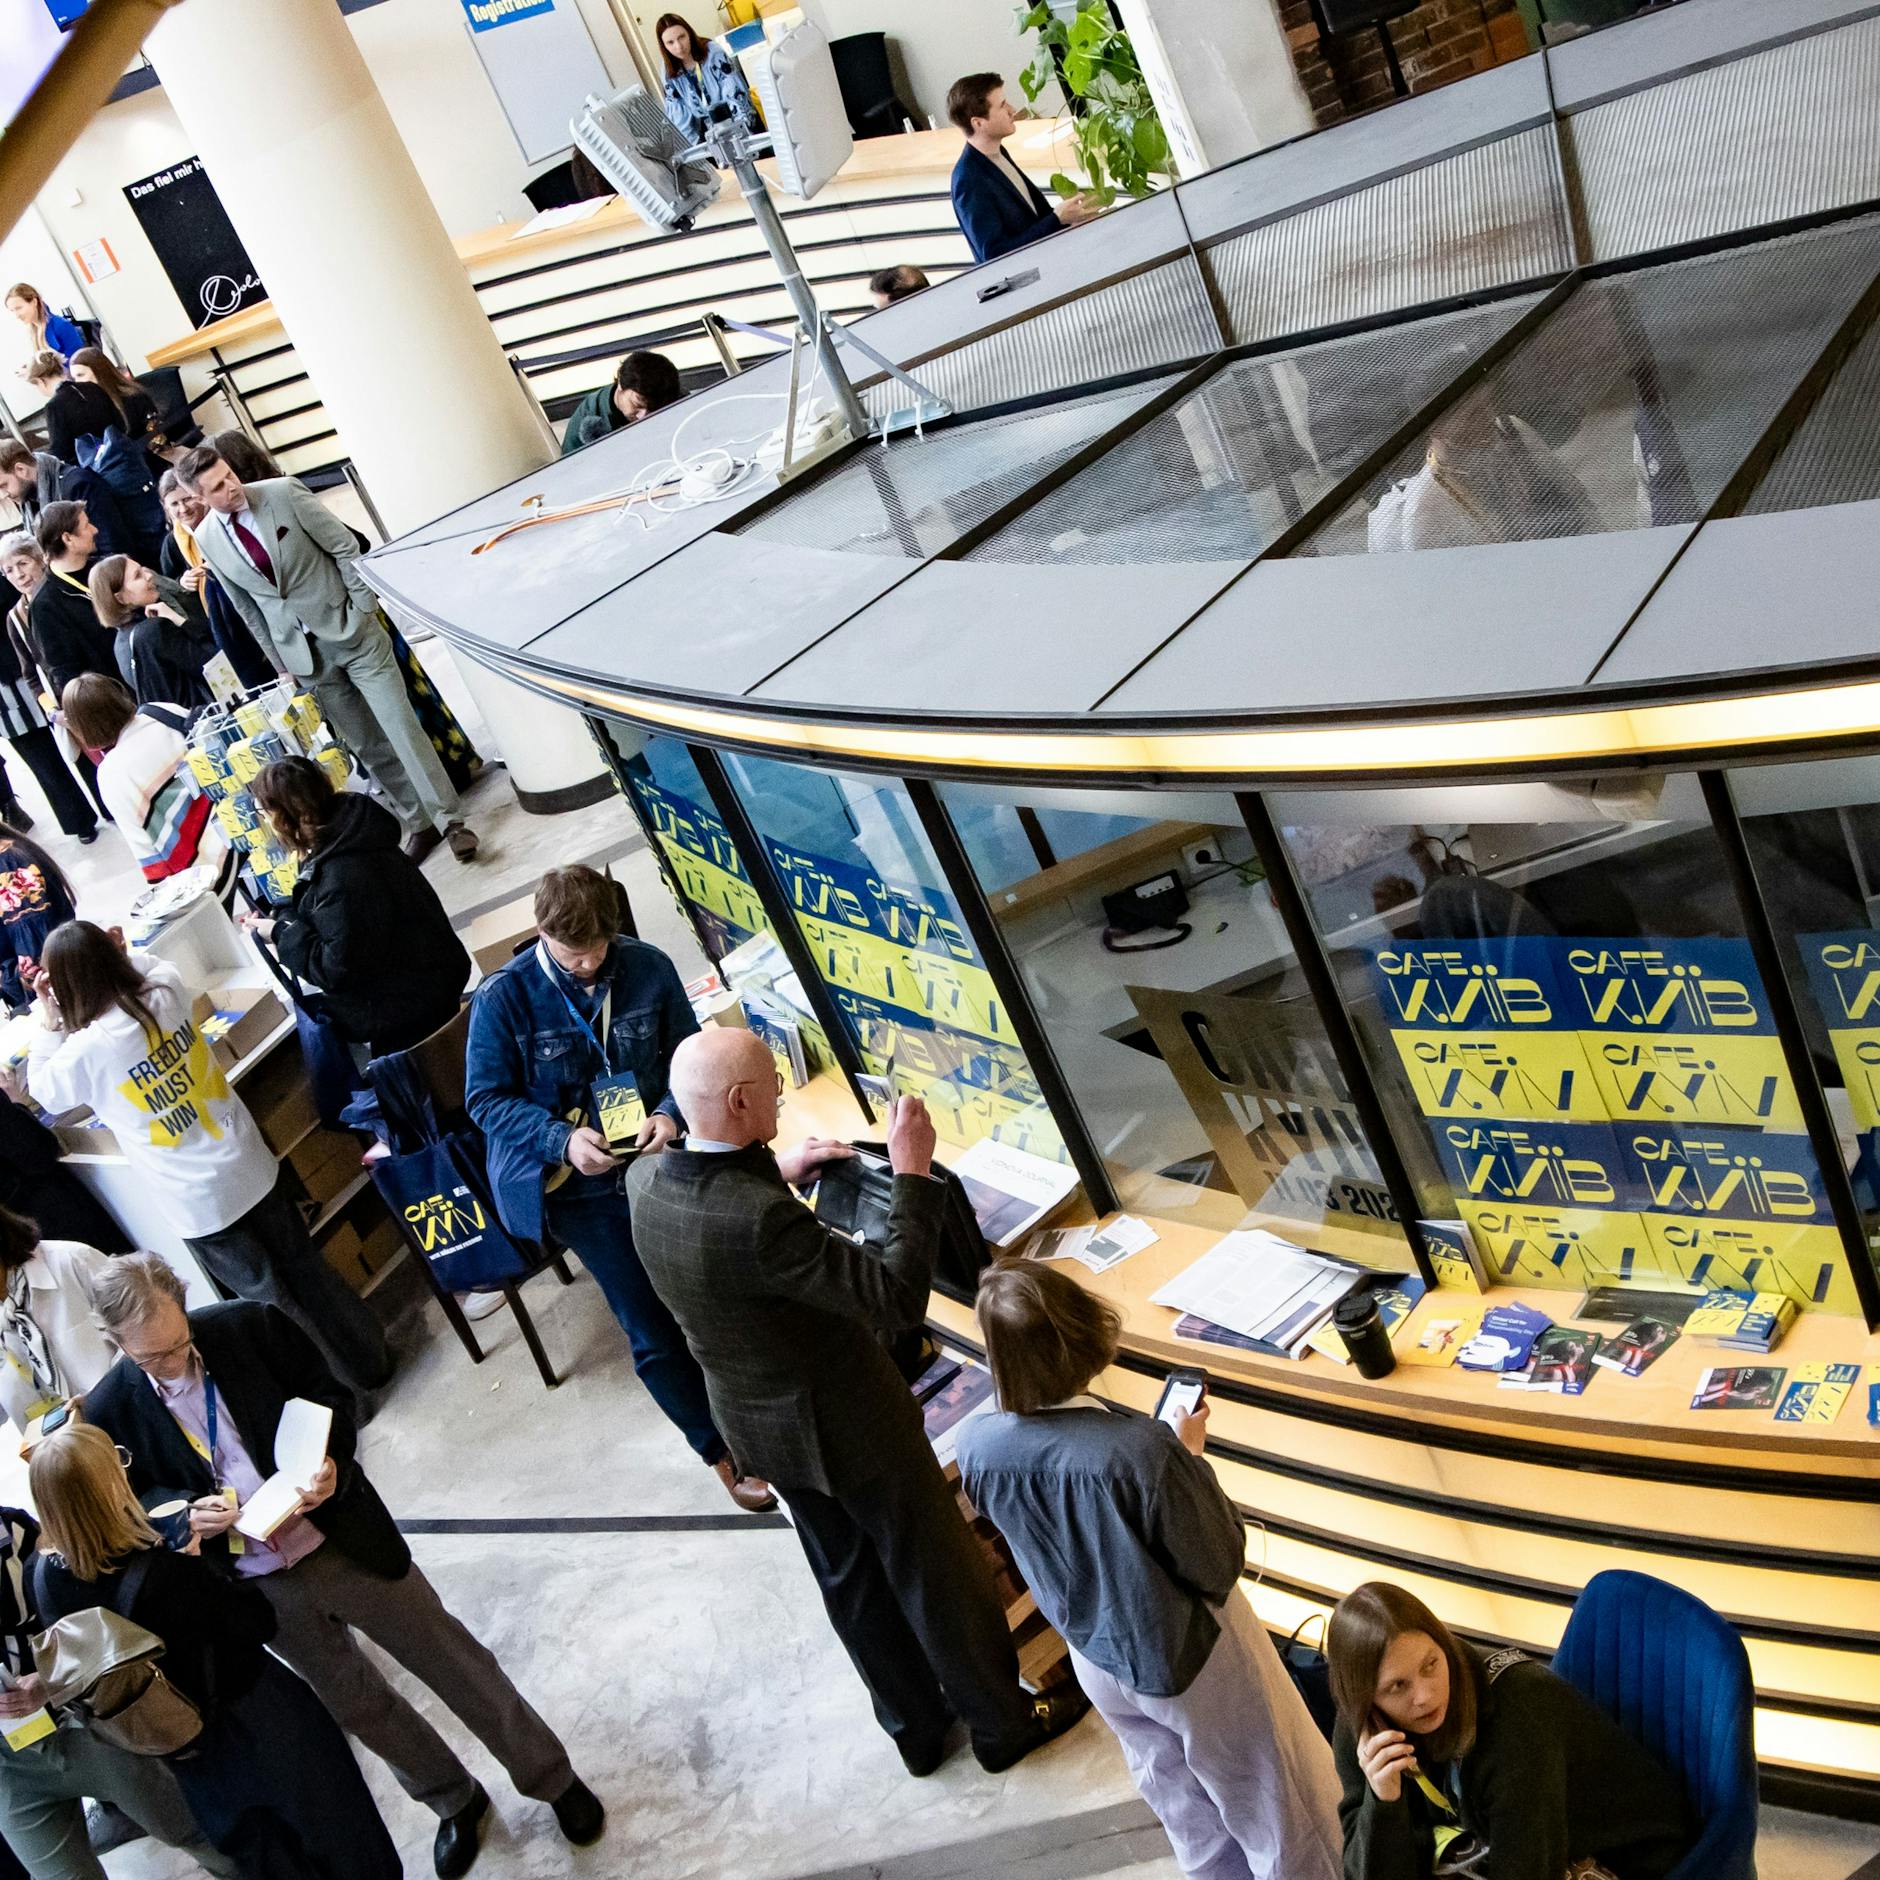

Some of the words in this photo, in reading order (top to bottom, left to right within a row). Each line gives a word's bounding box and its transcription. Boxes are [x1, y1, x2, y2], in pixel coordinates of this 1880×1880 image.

[130, 183, 155, 199] Das
[173, 164, 193, 180] mir
[1377, 951, 1468, 976] CAFE
[1567, 949, 1669, 976] CAFE
[1414, 1041, 1503, 1066] CAFE
[1602, 1043, 1701, 1070] CAFE
[144, 1063, 196, 1115] MUST
[158, 1100, 199, 1138] WIN
[1446, 1125, 1535, 1156] CAFE
[1632, 1136, 1731, 1166] CAFE
[404, 1194, 447, 1223] CAFE
[1477, 1211, 1566, 1240] CAFE
[1663, 1225, 1758, 1255] CAFE
